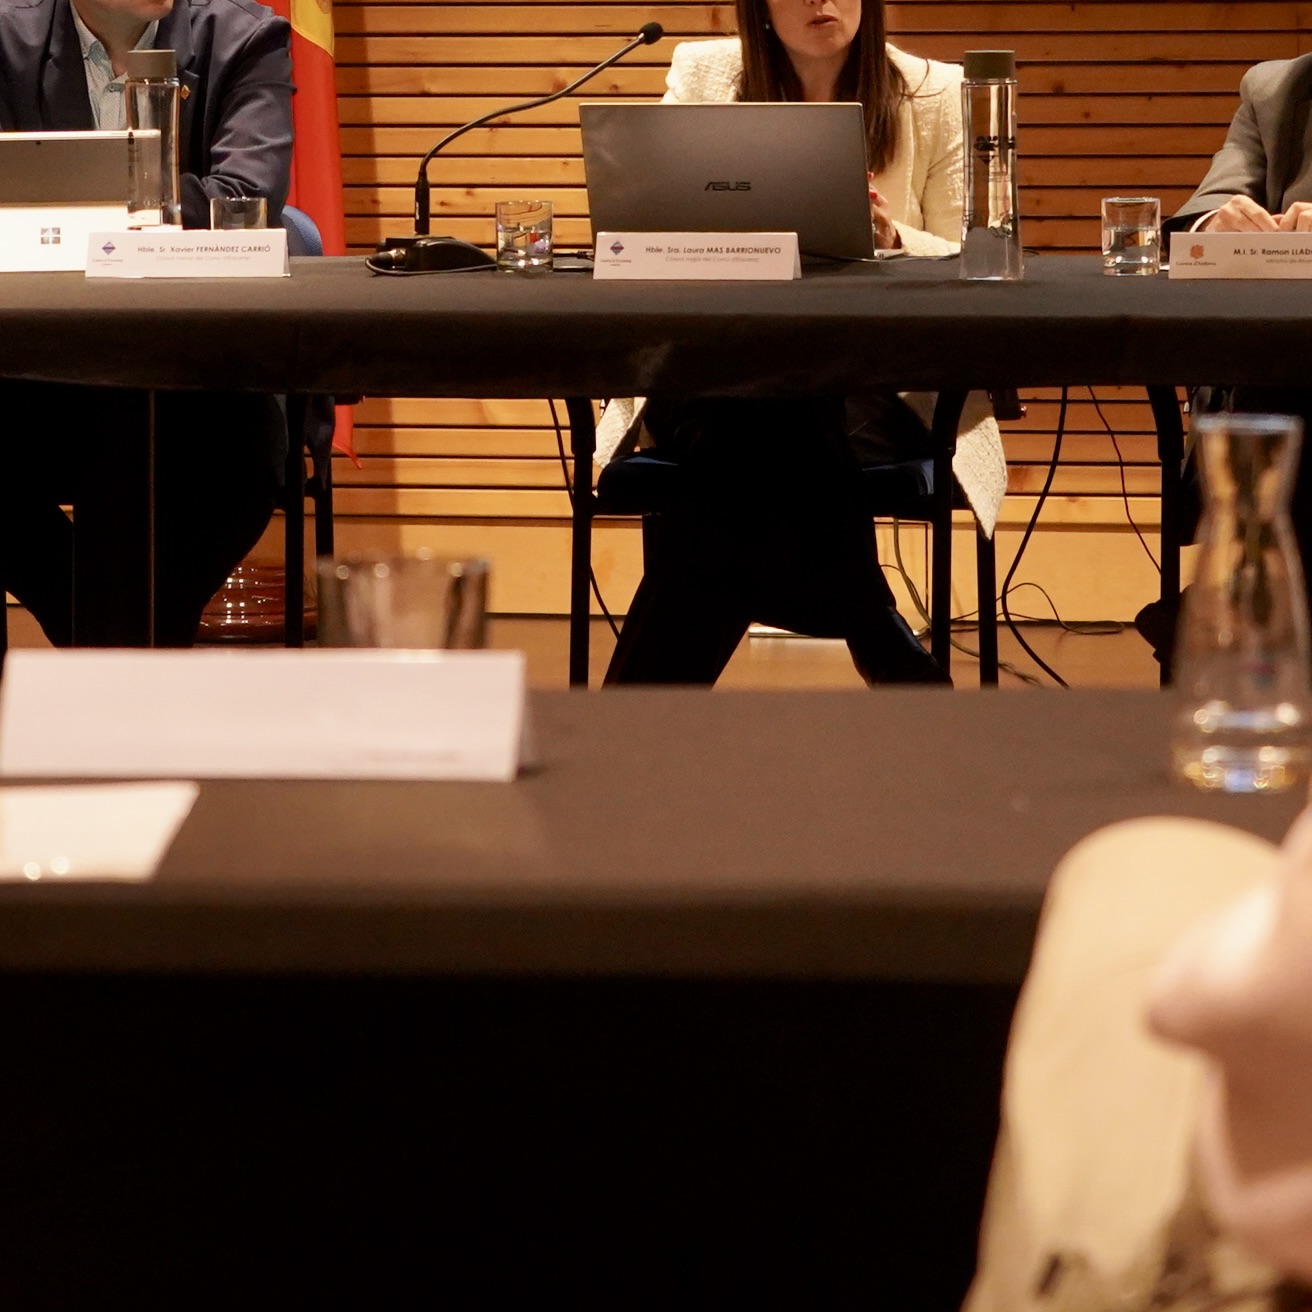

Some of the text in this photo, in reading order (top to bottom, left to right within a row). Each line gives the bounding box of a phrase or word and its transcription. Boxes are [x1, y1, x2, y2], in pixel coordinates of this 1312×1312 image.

[704, 181, 752, 191] ASUS
[241, 244, 271, 253] CARRIÓ
[1261, 248, 1289, 256] Ramon
